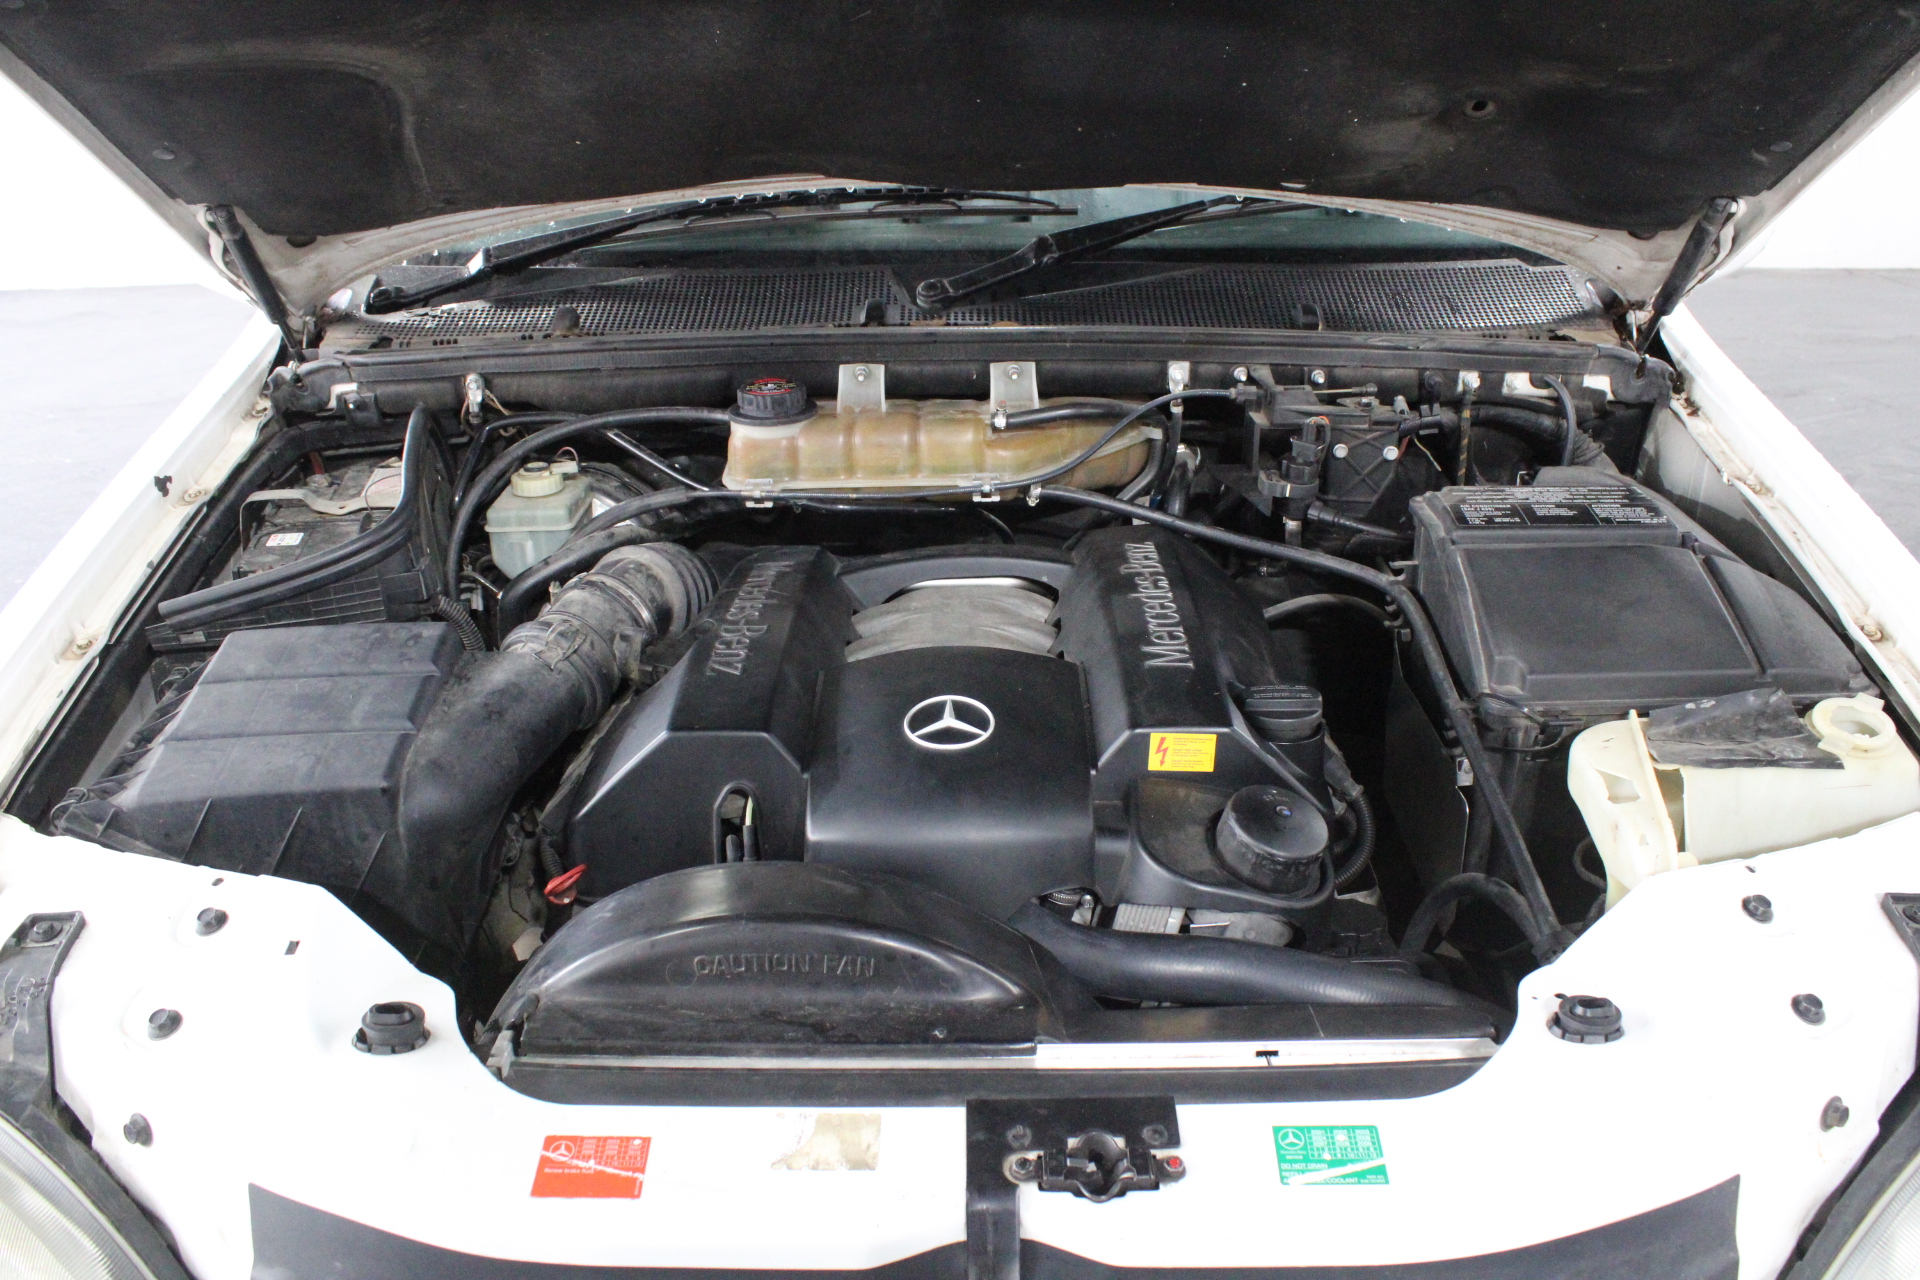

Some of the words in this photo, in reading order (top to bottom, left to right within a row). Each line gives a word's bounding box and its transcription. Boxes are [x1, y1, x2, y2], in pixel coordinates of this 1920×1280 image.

[1119, 541, 1195, 669] Mercedes-Benz
[693, 953, 810, 976] CAUTION
[823, 954, 876, 977] FAN
